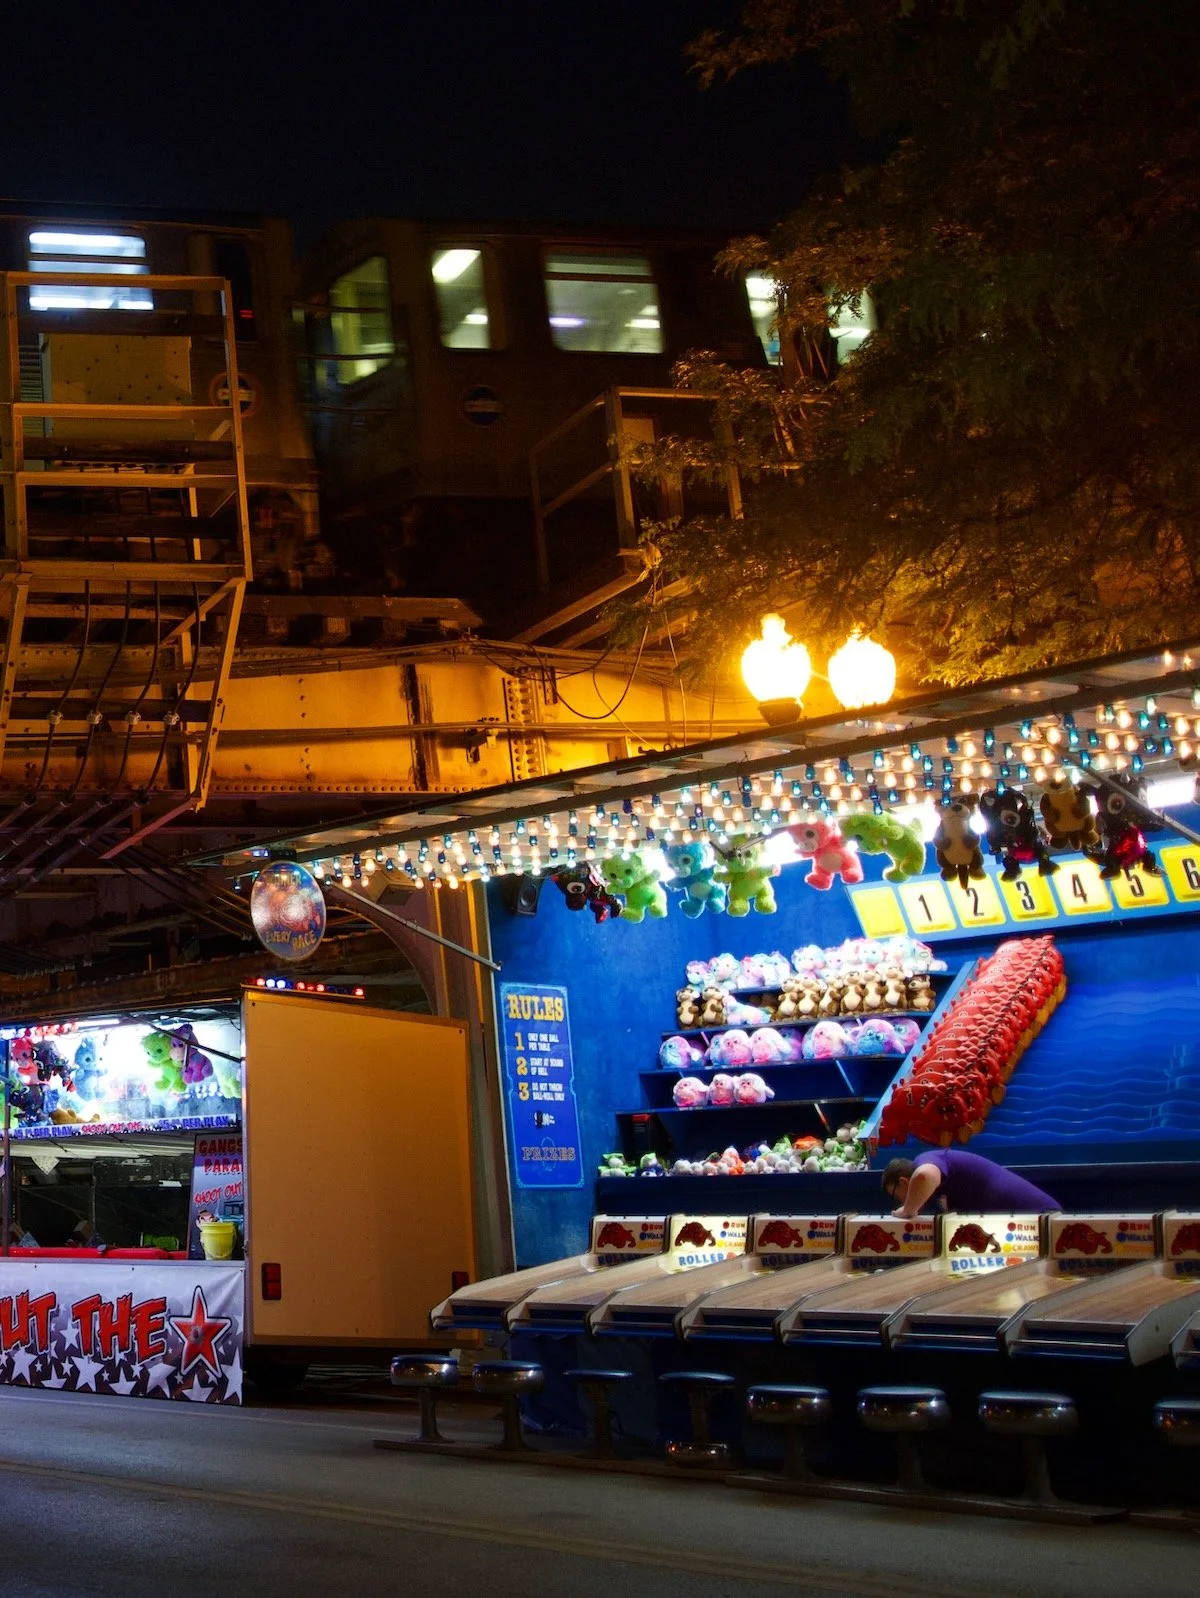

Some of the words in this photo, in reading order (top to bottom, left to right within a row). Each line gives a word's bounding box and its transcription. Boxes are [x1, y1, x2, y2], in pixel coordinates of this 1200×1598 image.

[1125, 866, 1144, 898] 5
[1182, 857, 1200, 891] 6
[1016, 881, 1035, 911] 3
[1071, 873, 1087, 903] 4
[917, 894, 932, 922] 1
[965, 887, 984, 917] 2
[507, 994, 564, 1021] RULES
[515, 1032, 524, 1050] 1
[516, 1057, 528, 1076] 2
[518, 1082, 530, 1101] 3
[51, 1126, 73, 1137] PLAY
[182, 1118, 201, 1129] PER
[203, 1116, 229, 1127] PLAY
[521, 1147, 576, 1161] PRIZES
[203, 1158, 241, 1173] PARA
[224, 1182, 241, 1199] OUT
[819, 1222, 834, 1230] RUN
[914, 1223, 931, 1231] RUN
[1016, 1224, 1036, 1232] RUN
[1014, 1234, 1039, 1242] WALK
[679, 1252, 725, 1267] ROLLER
[951, 1257, 1005, 1272] ROLLER
[70, 1291, 167, 1364] THE
